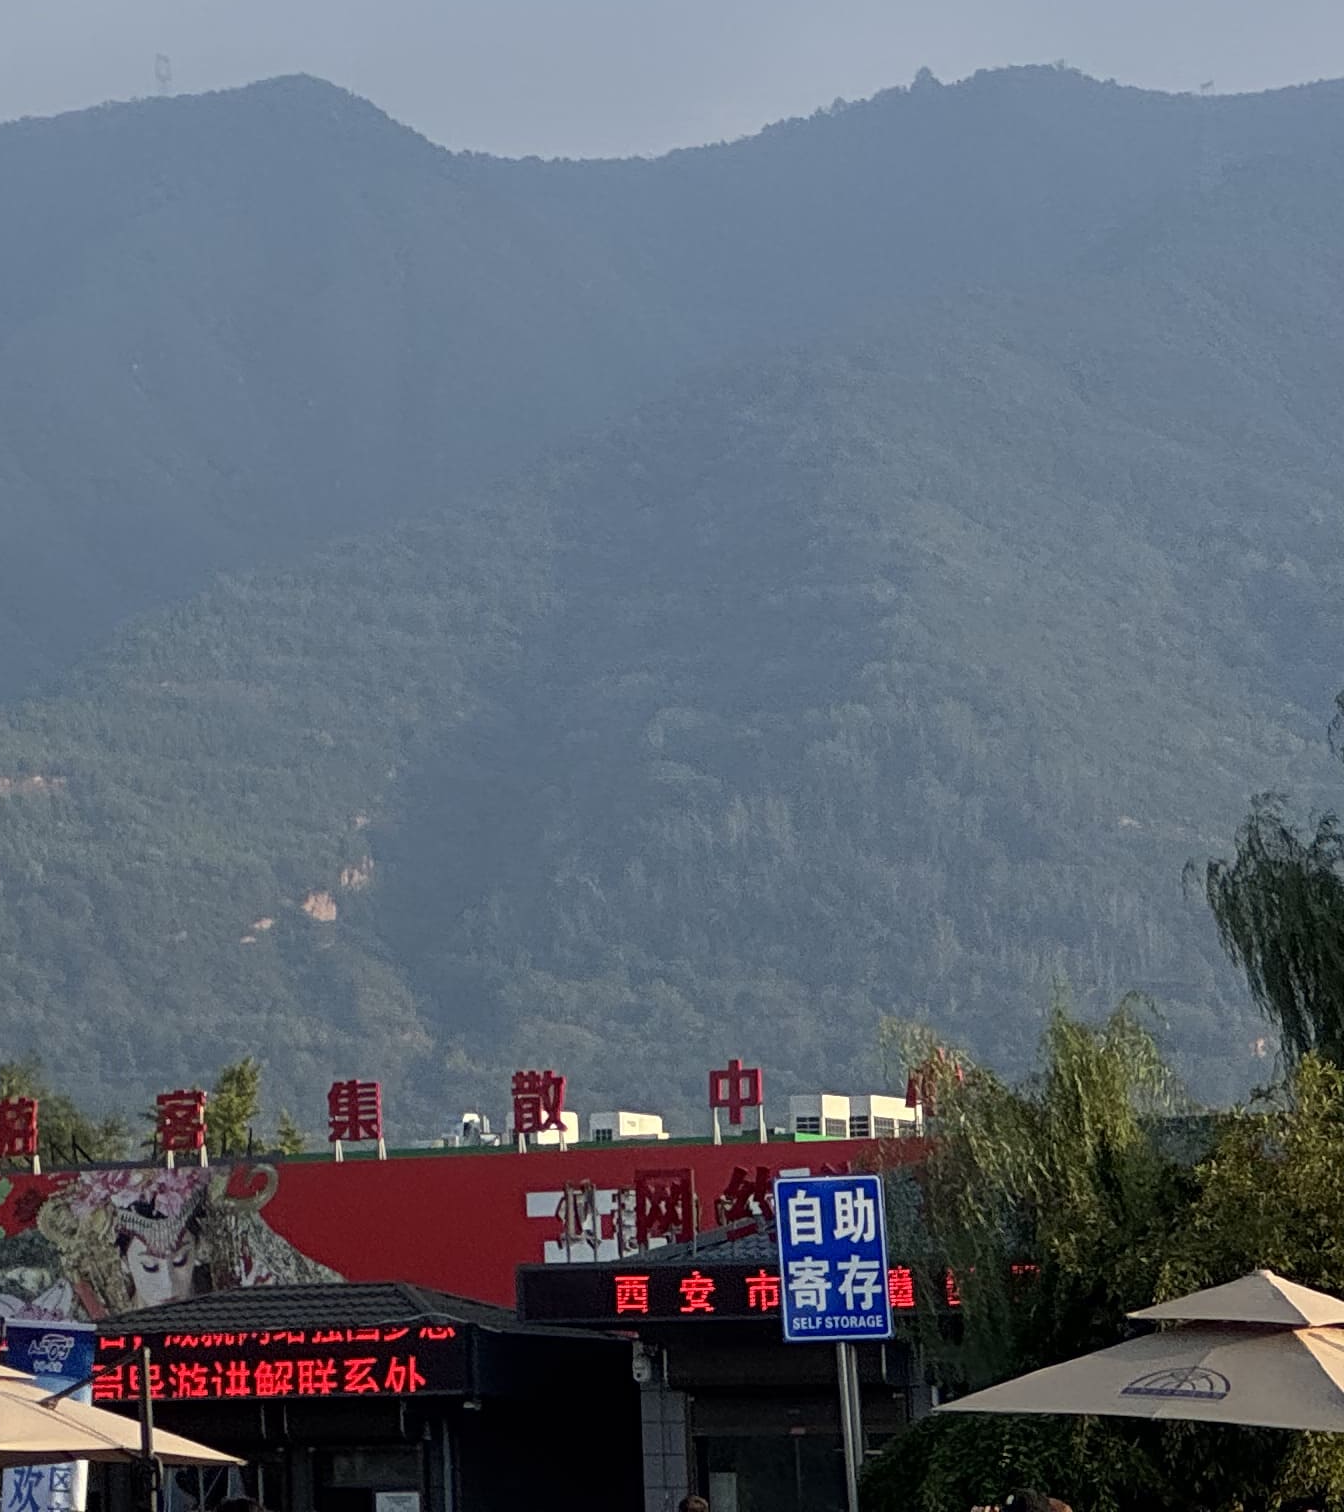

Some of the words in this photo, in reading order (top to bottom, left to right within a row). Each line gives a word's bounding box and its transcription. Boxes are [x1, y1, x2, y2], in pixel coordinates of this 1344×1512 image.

[788, 1188, 876, 1245] 自助
[788, 1254, 883, 1312] 寄存
[792, 1316, 823, 1331] SELF
[825, 1314, 884, 1330] STORAGE
